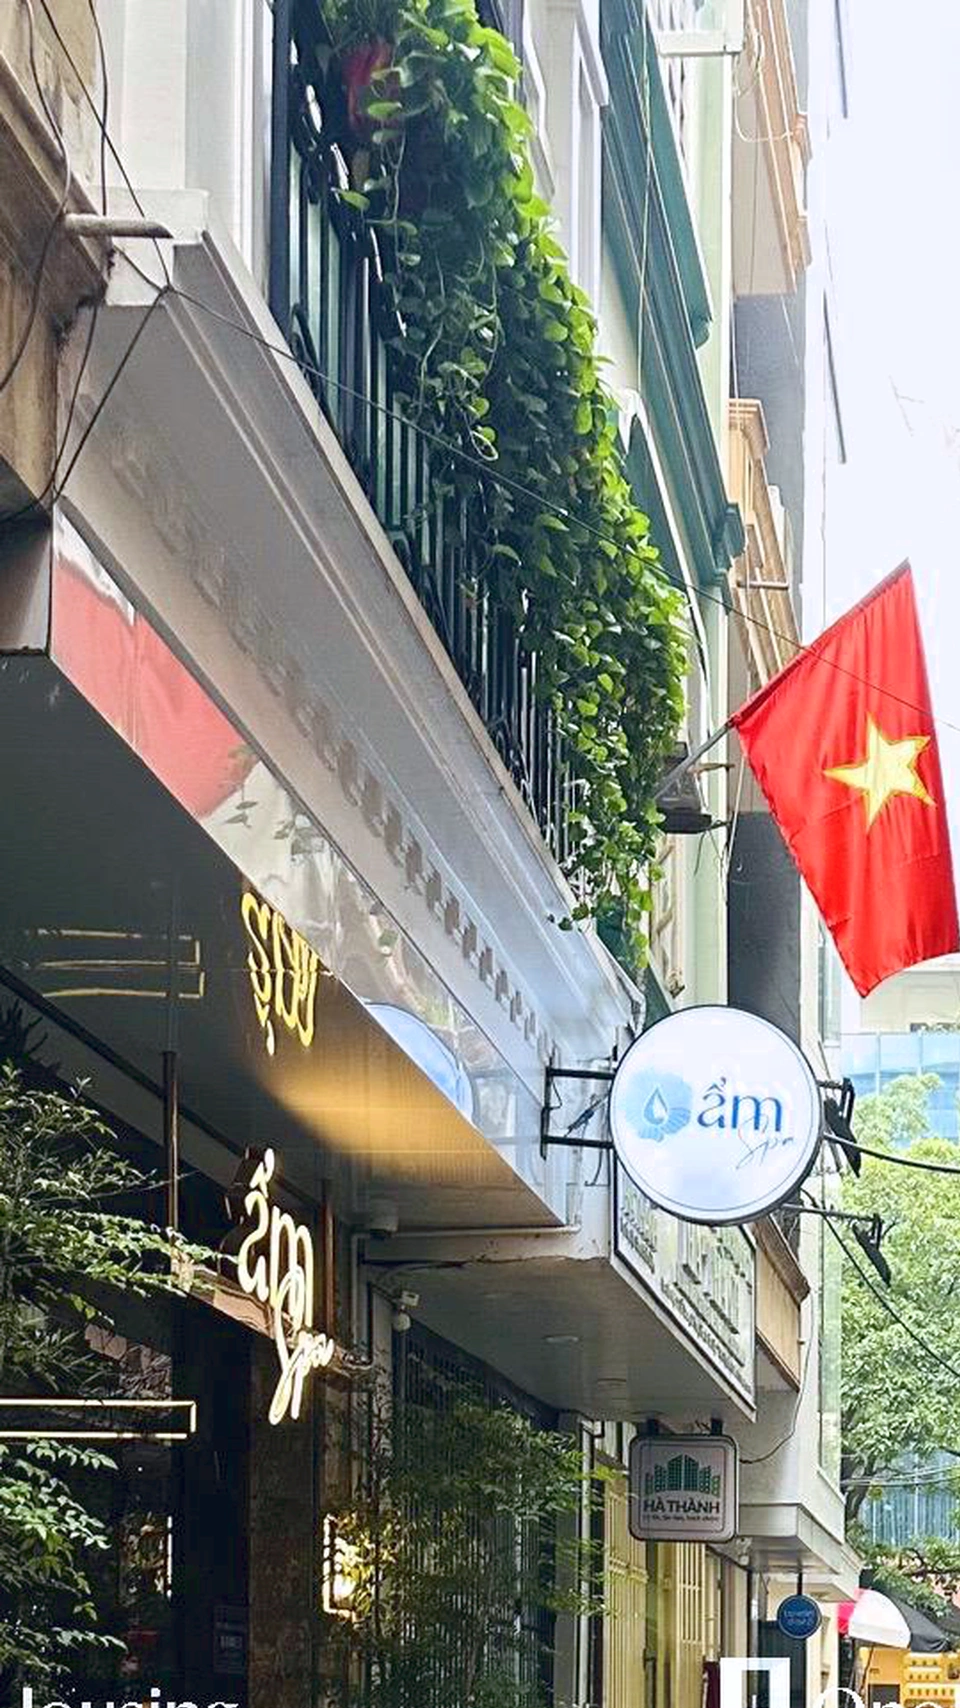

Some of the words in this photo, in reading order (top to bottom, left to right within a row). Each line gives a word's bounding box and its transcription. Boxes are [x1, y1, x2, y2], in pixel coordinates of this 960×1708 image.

[697, 1076, 783, 1132] ẩm
[643, 1496, 666, 1513] HÀ
[666, 1497, 720, 1514] THÀNH
